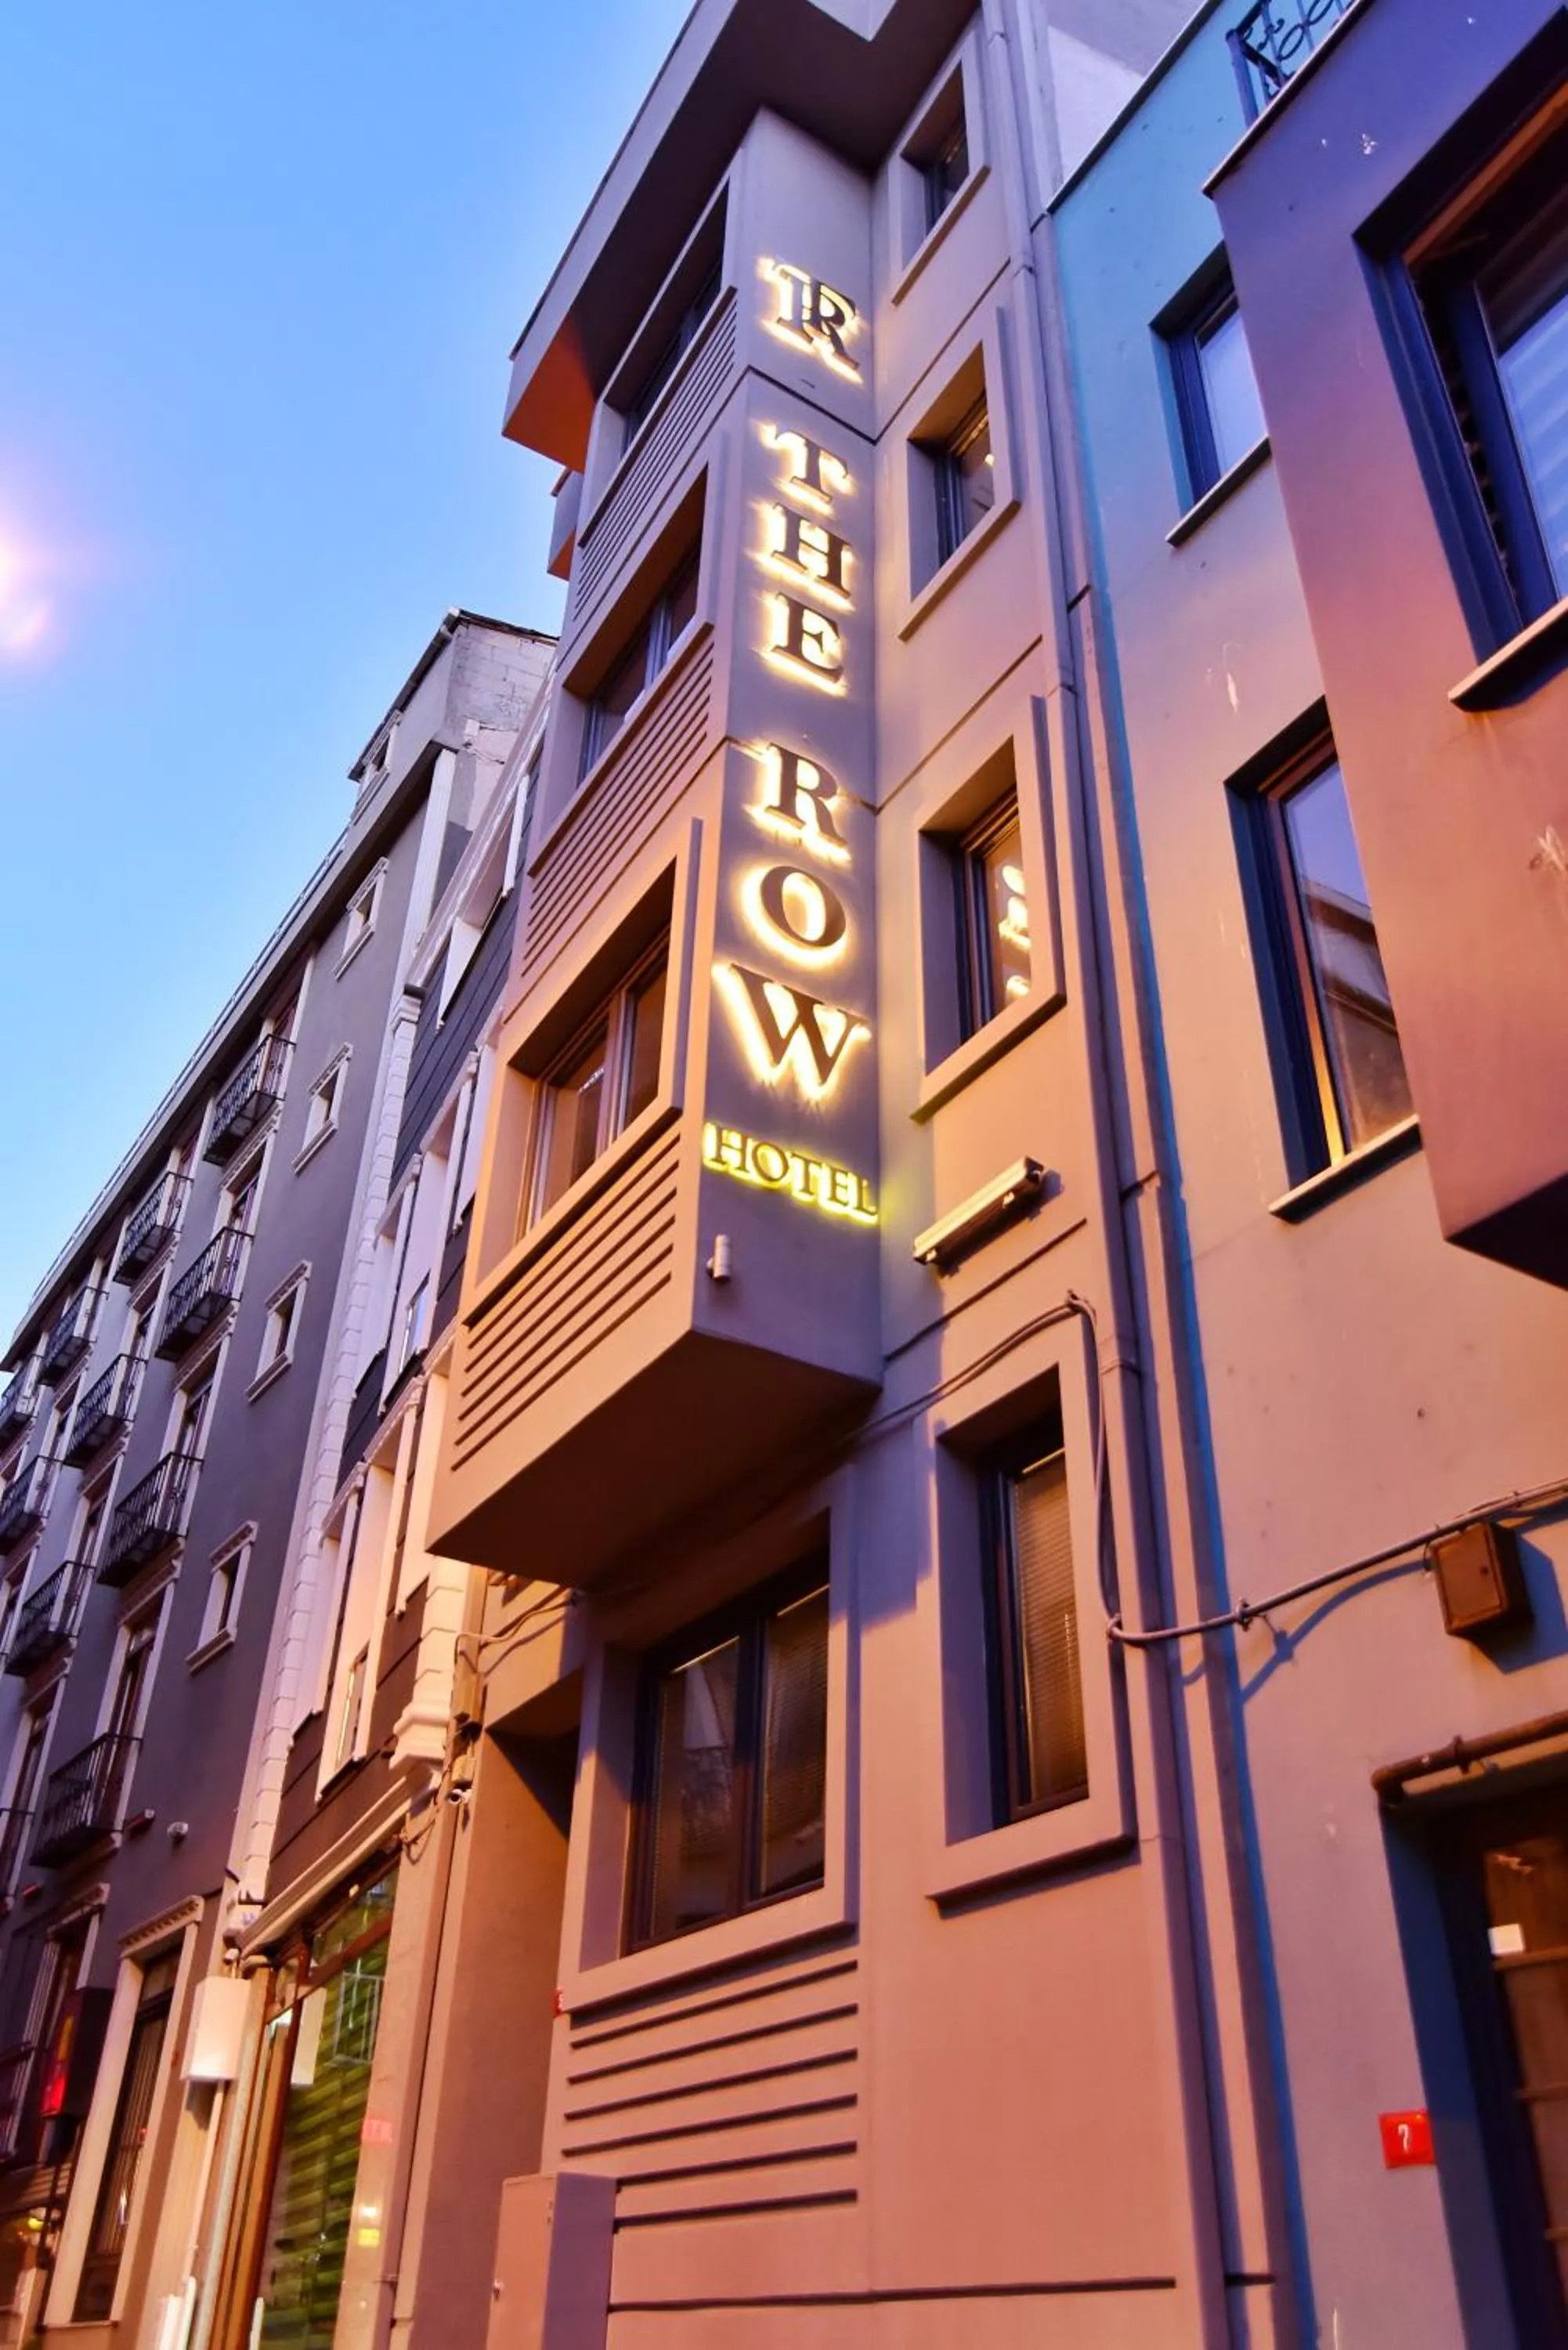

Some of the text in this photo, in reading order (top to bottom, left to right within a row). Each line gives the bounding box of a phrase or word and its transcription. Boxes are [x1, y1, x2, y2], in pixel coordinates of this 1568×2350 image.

[731, 428, 869, 1086] THE ROW
[711, 1123, 878, 1216] HOTEL
